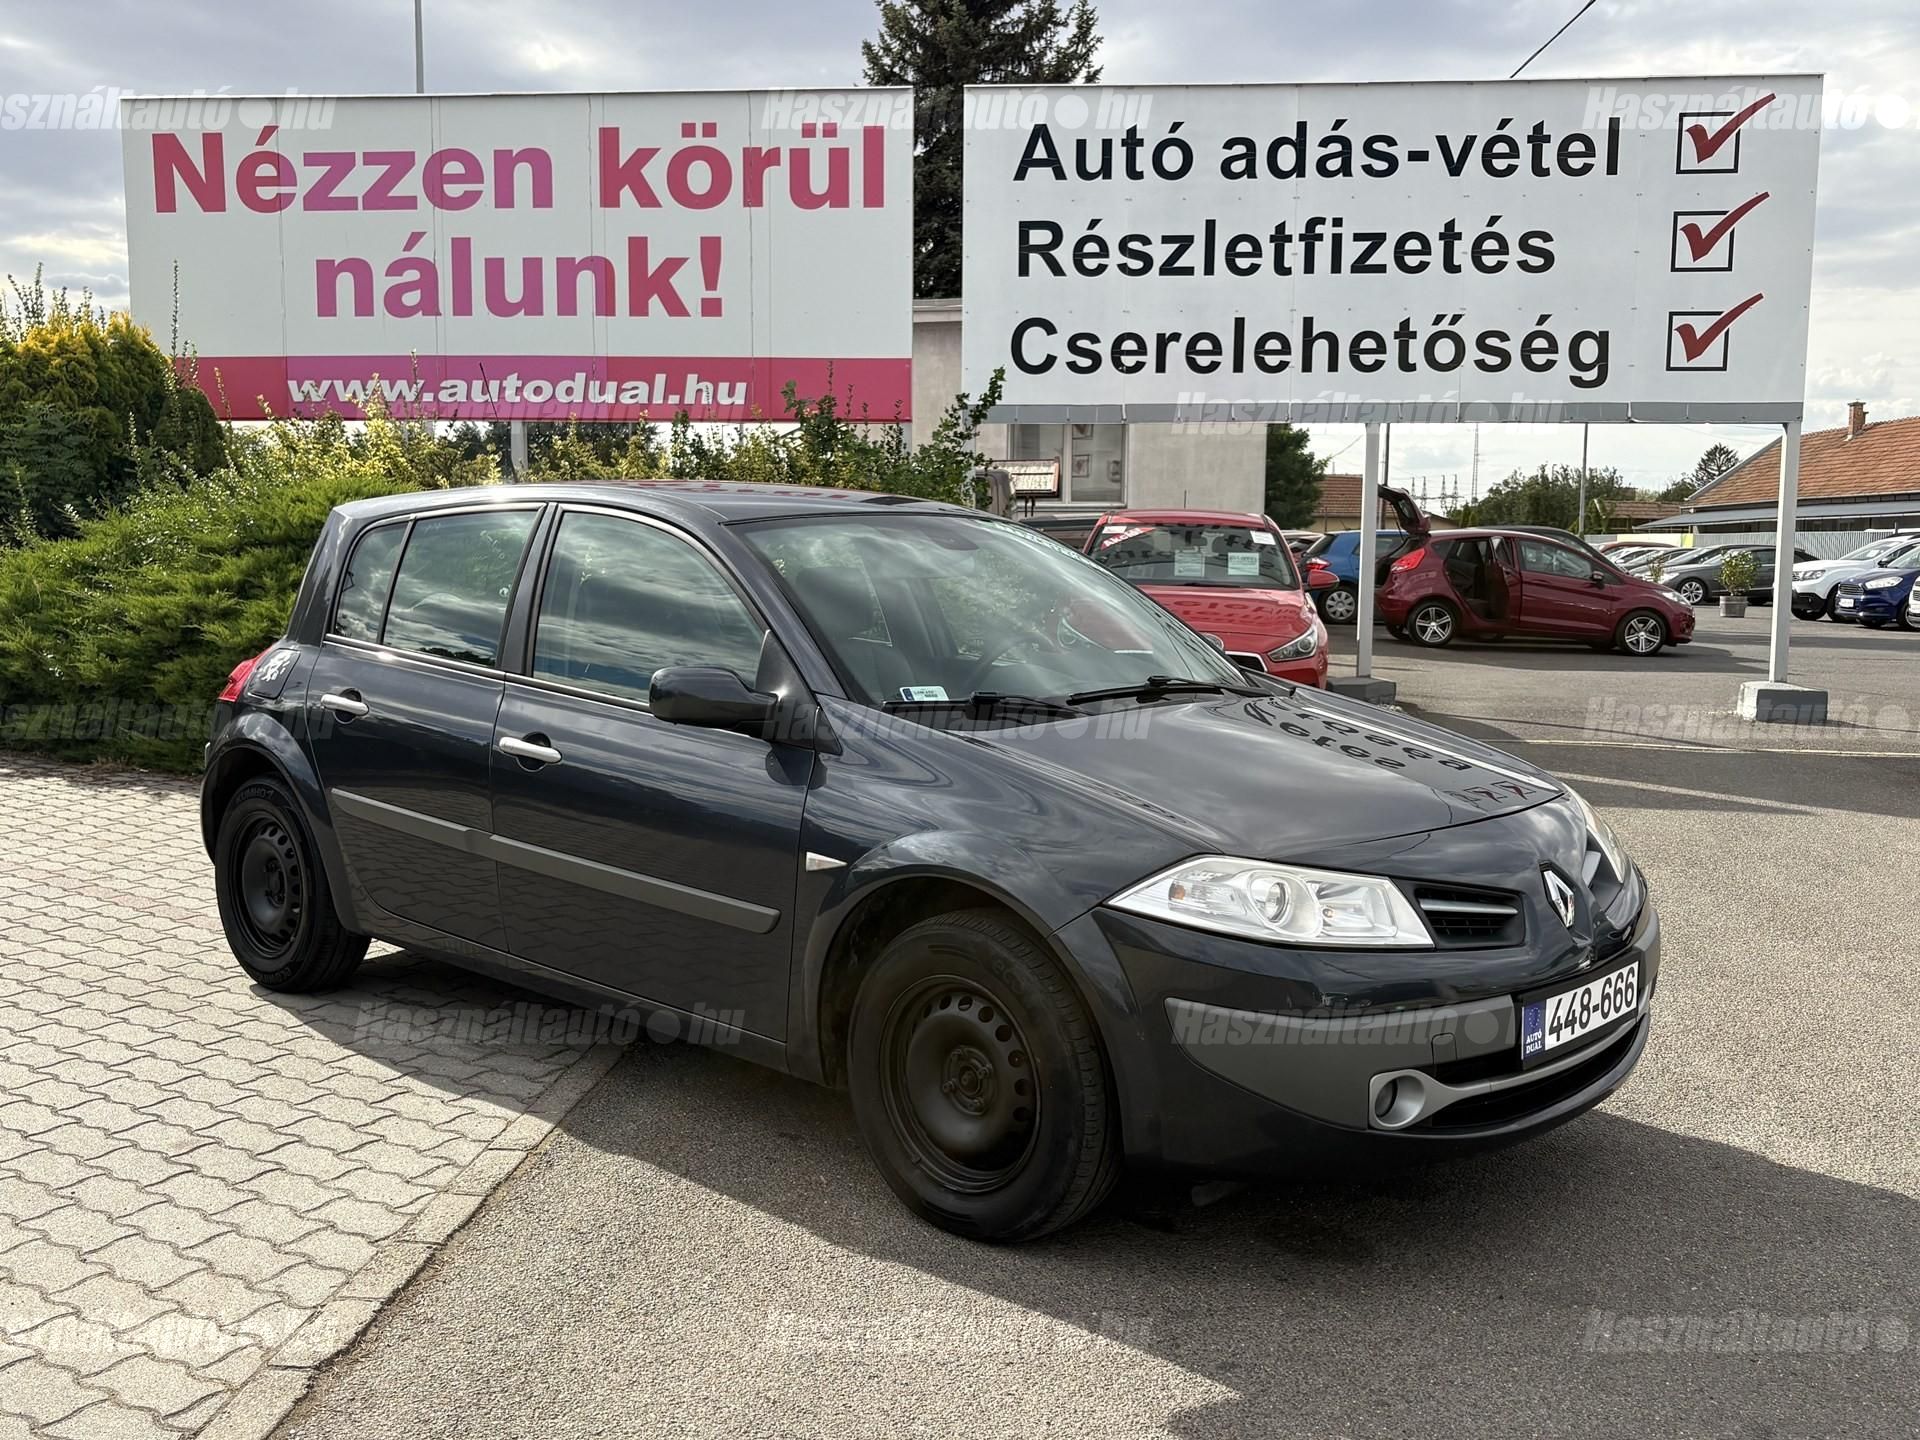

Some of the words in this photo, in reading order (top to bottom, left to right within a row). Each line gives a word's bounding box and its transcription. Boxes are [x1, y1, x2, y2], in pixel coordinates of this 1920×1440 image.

[153, 126, 553, 213] Nézzen
[599, 122, 885, 210] körül
[1013, 121, 1194, 181] Autó
[1220, 117, 1621, 180] adás-vétel
[316, 232, 724, 318] nálunk!
[1018, 215, 1556, 278] Részletfizetés
[1010, 313, 1611, 389] Cserelehetőség
[286, 371, 748, 406] www.autodual.hu
[1525, 1028, 1543, 1045] AUTÓ
[1548, 966, 1636, 1043] 448-666
[1525, 1040, 1543, 1055] DUAL
